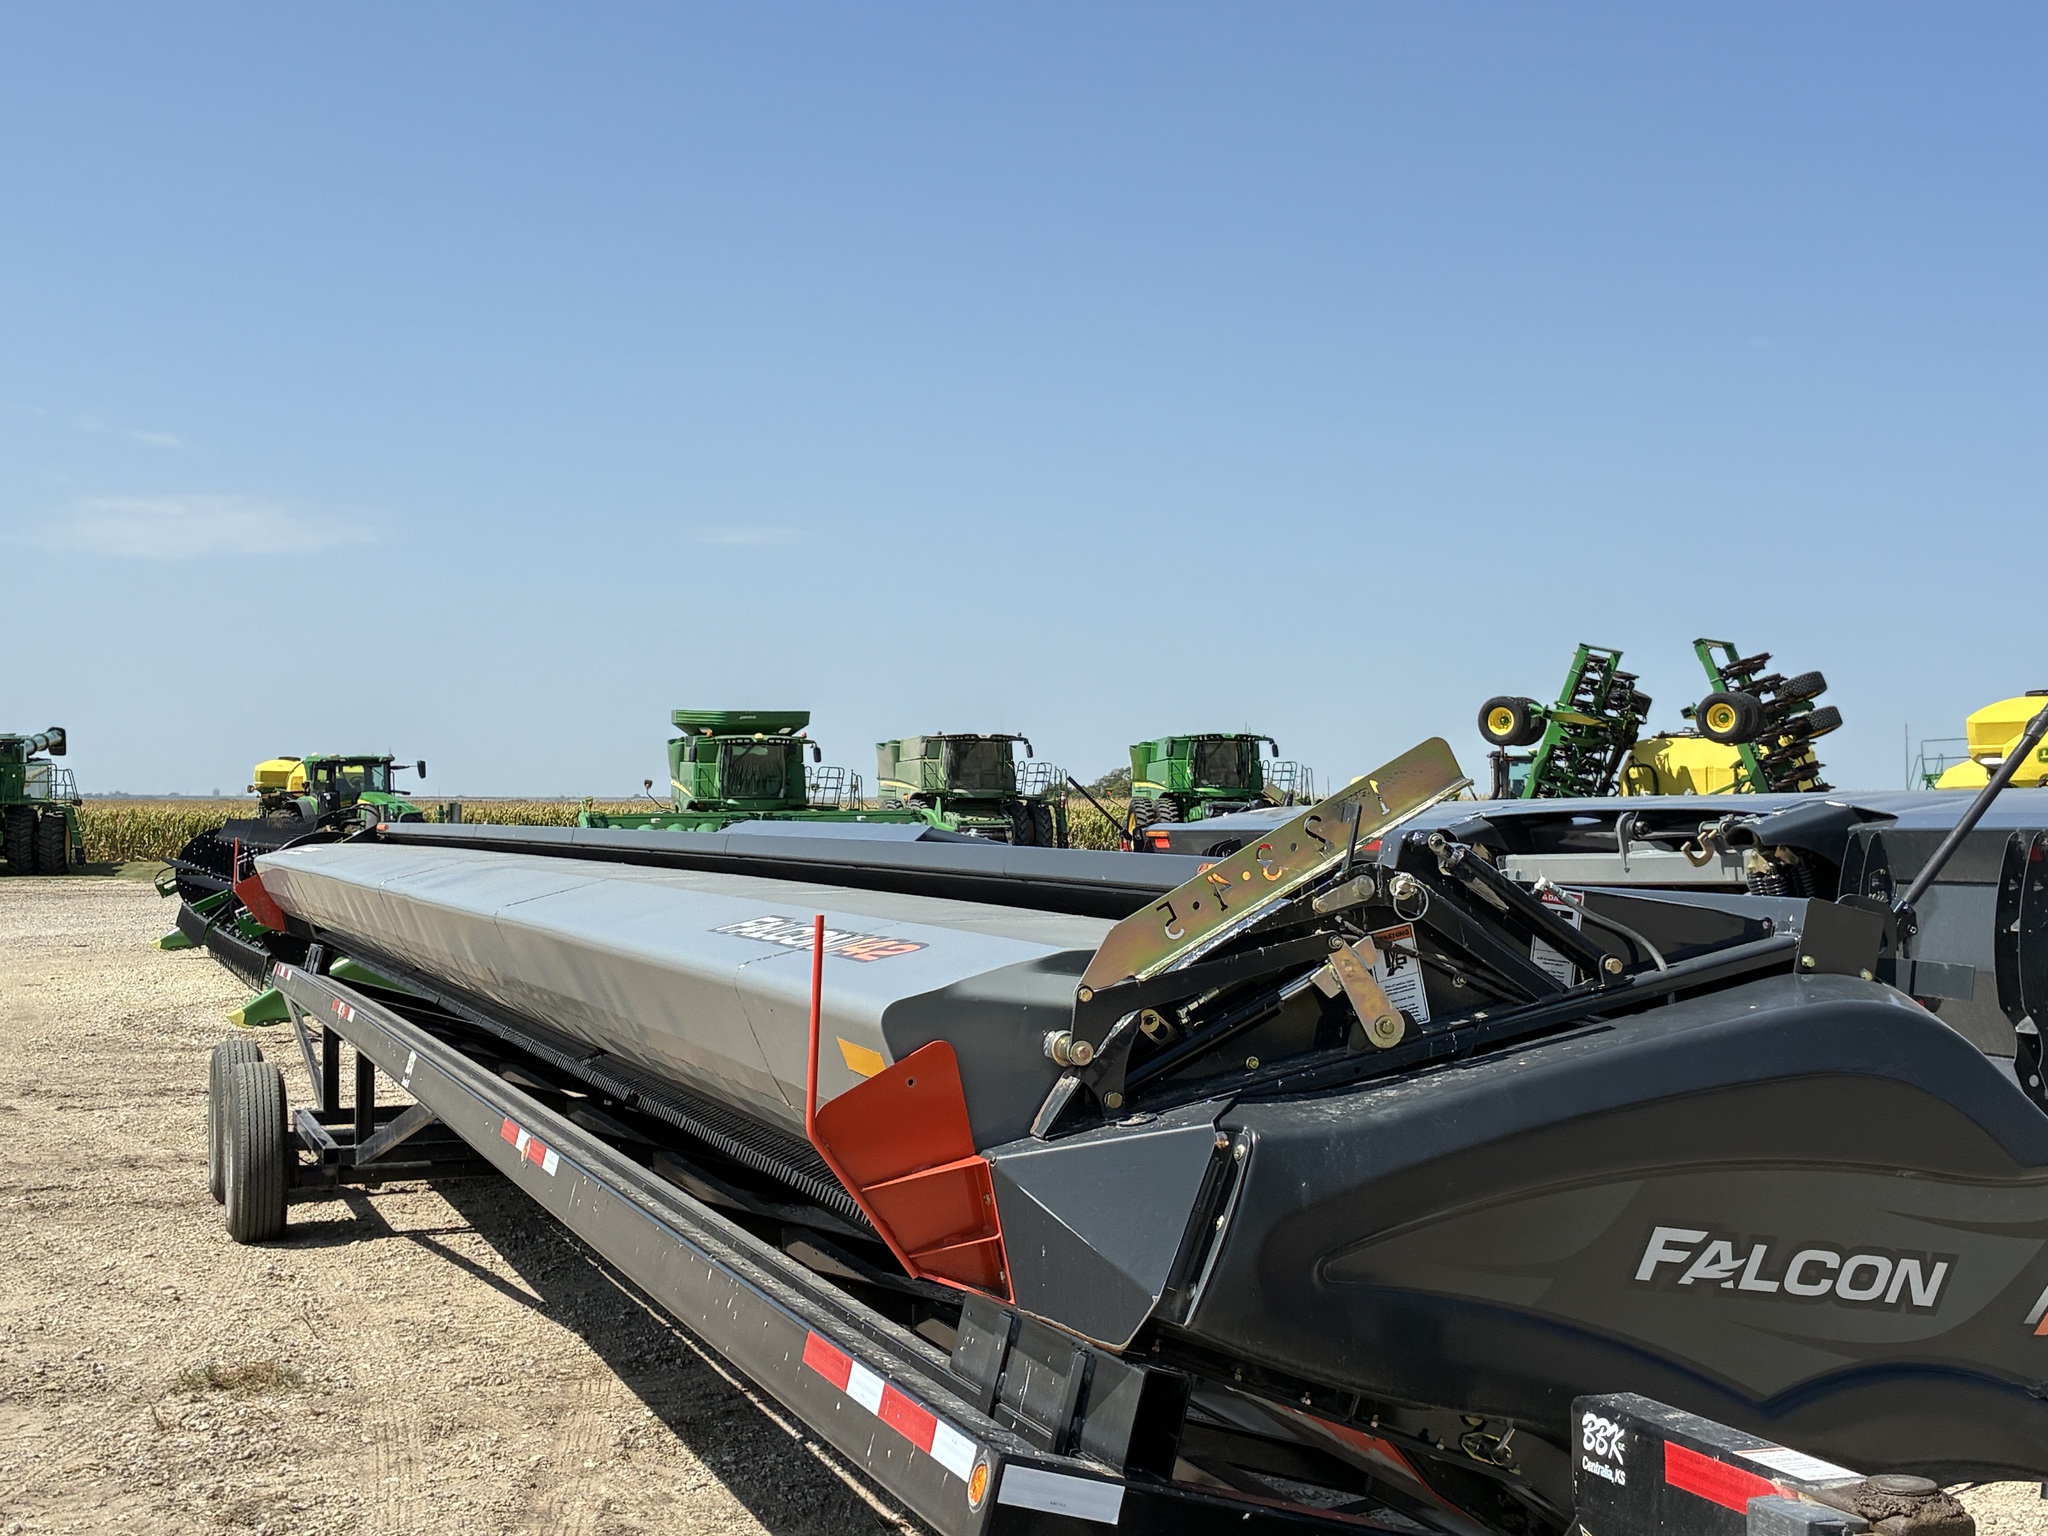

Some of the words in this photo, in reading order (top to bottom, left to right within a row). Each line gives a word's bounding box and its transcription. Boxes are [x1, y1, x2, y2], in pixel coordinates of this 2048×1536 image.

[716, 916, 864, 951] FALCON
[1634, 1226, 1949, 1307] FALCON
[1614, 1468, 1627, 1486] KS
